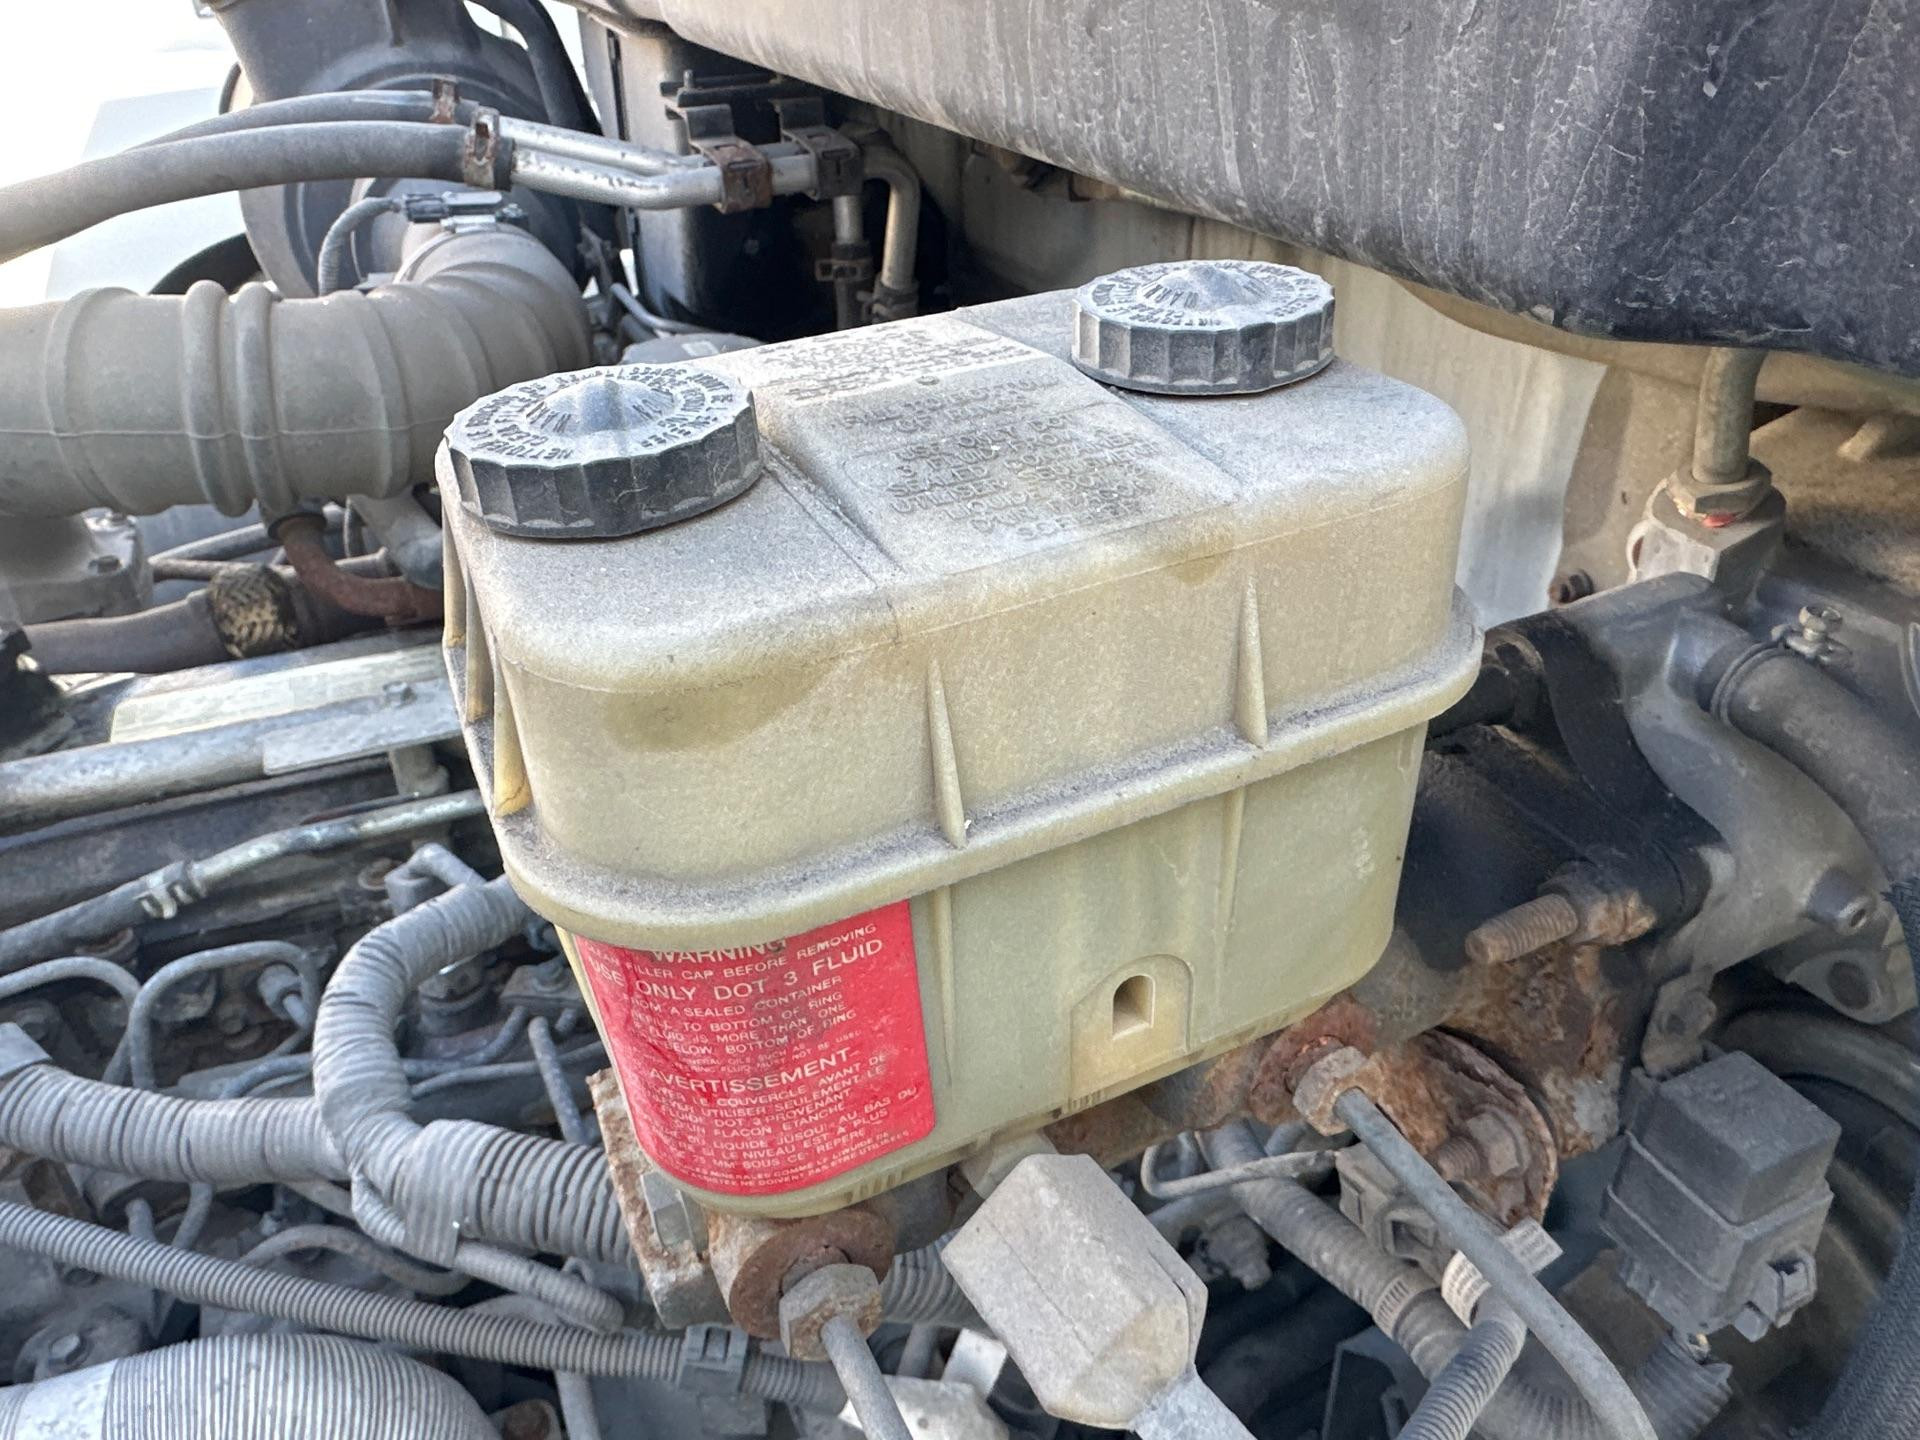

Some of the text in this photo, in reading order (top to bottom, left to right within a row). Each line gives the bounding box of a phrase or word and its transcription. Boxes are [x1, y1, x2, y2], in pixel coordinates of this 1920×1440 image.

[894, 415, 1076, 461] USE ONLY DOT
[925, 447, 999, 470] FLUID
[1007, 431, 1077, 450] FROM
[886, 432, 1144, 496] SEALED CONTAINER
[890, 441, 1165, 513] UTILISER SEULEMENT
[942, 489, 1045, 518] LIQUIDE
[588, 936, 882, 1000] USE ONLY DOT 3 FLUID
[625, 961, 673, 979] FILLER
[681, 970, 714, 978] CAP
[722, 956, 787, 976] BEFORE
[796, 922, 875, 960] REMOVING
[668, 1006, 680, 1015] A
[683, 1003, 745, 1017] SEALED
[755, 975, 841, 1009] CONTAINER
[683, 1023, 702, 1031] TO
[710, 1013, 773, 1031] BOTTOM
[780, 1006, 800, 1018] OF
[809, 990, 841, 1009] RING
[665, 1041, 712, 1054] BELOW
[727, 1033, 788, 1053] BOTTOM
[797, 1025, 814, 1037] OF
[716, 1028, 758, 1042] MORE
[770, 1016, 807, 1033] THAN
[817, 1001, 845, 1018] ONE
[647, 1047, 851, 1095] AVERTISSEMENT
[757, 1055, 786, 1069] MUST
[791, 1049, 814, 1060] NOT
[818, 1040, 832, 1050] BE
[758, 1047, 787, 1061] SUCH
[702, 1067, 884, 1119] UTILISER SEULEMENT LE
[717, 1083, 806, 1108] COUVERCLE
[819, 1063, 860, 1085] AVANT
[869, 1055, 885, 1066] DE
[713, 1139, 769, 1149] LIQUIDE
[838, 1111, 857, 1124] AU
[864, 1097, 891, 1113] BAS
[898, 1087, 917, 1100] DU
[713, 1125, 771, 1137] FLACON
[783, 1101, 845, 1129] ETANCHE
[766, 1087, 851, 1123] PROVENANT
[712, 1159, 735, 1168] MM
[743, 1157, 780, 1168] SOUS
[787, 1151, 805, 1163] CE
[817, 1126, 864, 1155] REPERE
[743, 1143, 795, 1159] NIVEAU
[804, 1132, 828, 1148] EST
[853, 1109, 888, 1127] PLUS
[757, 1173, 804, 1185] DOIVENT
[773, 1162, 814, 1177] COMME
